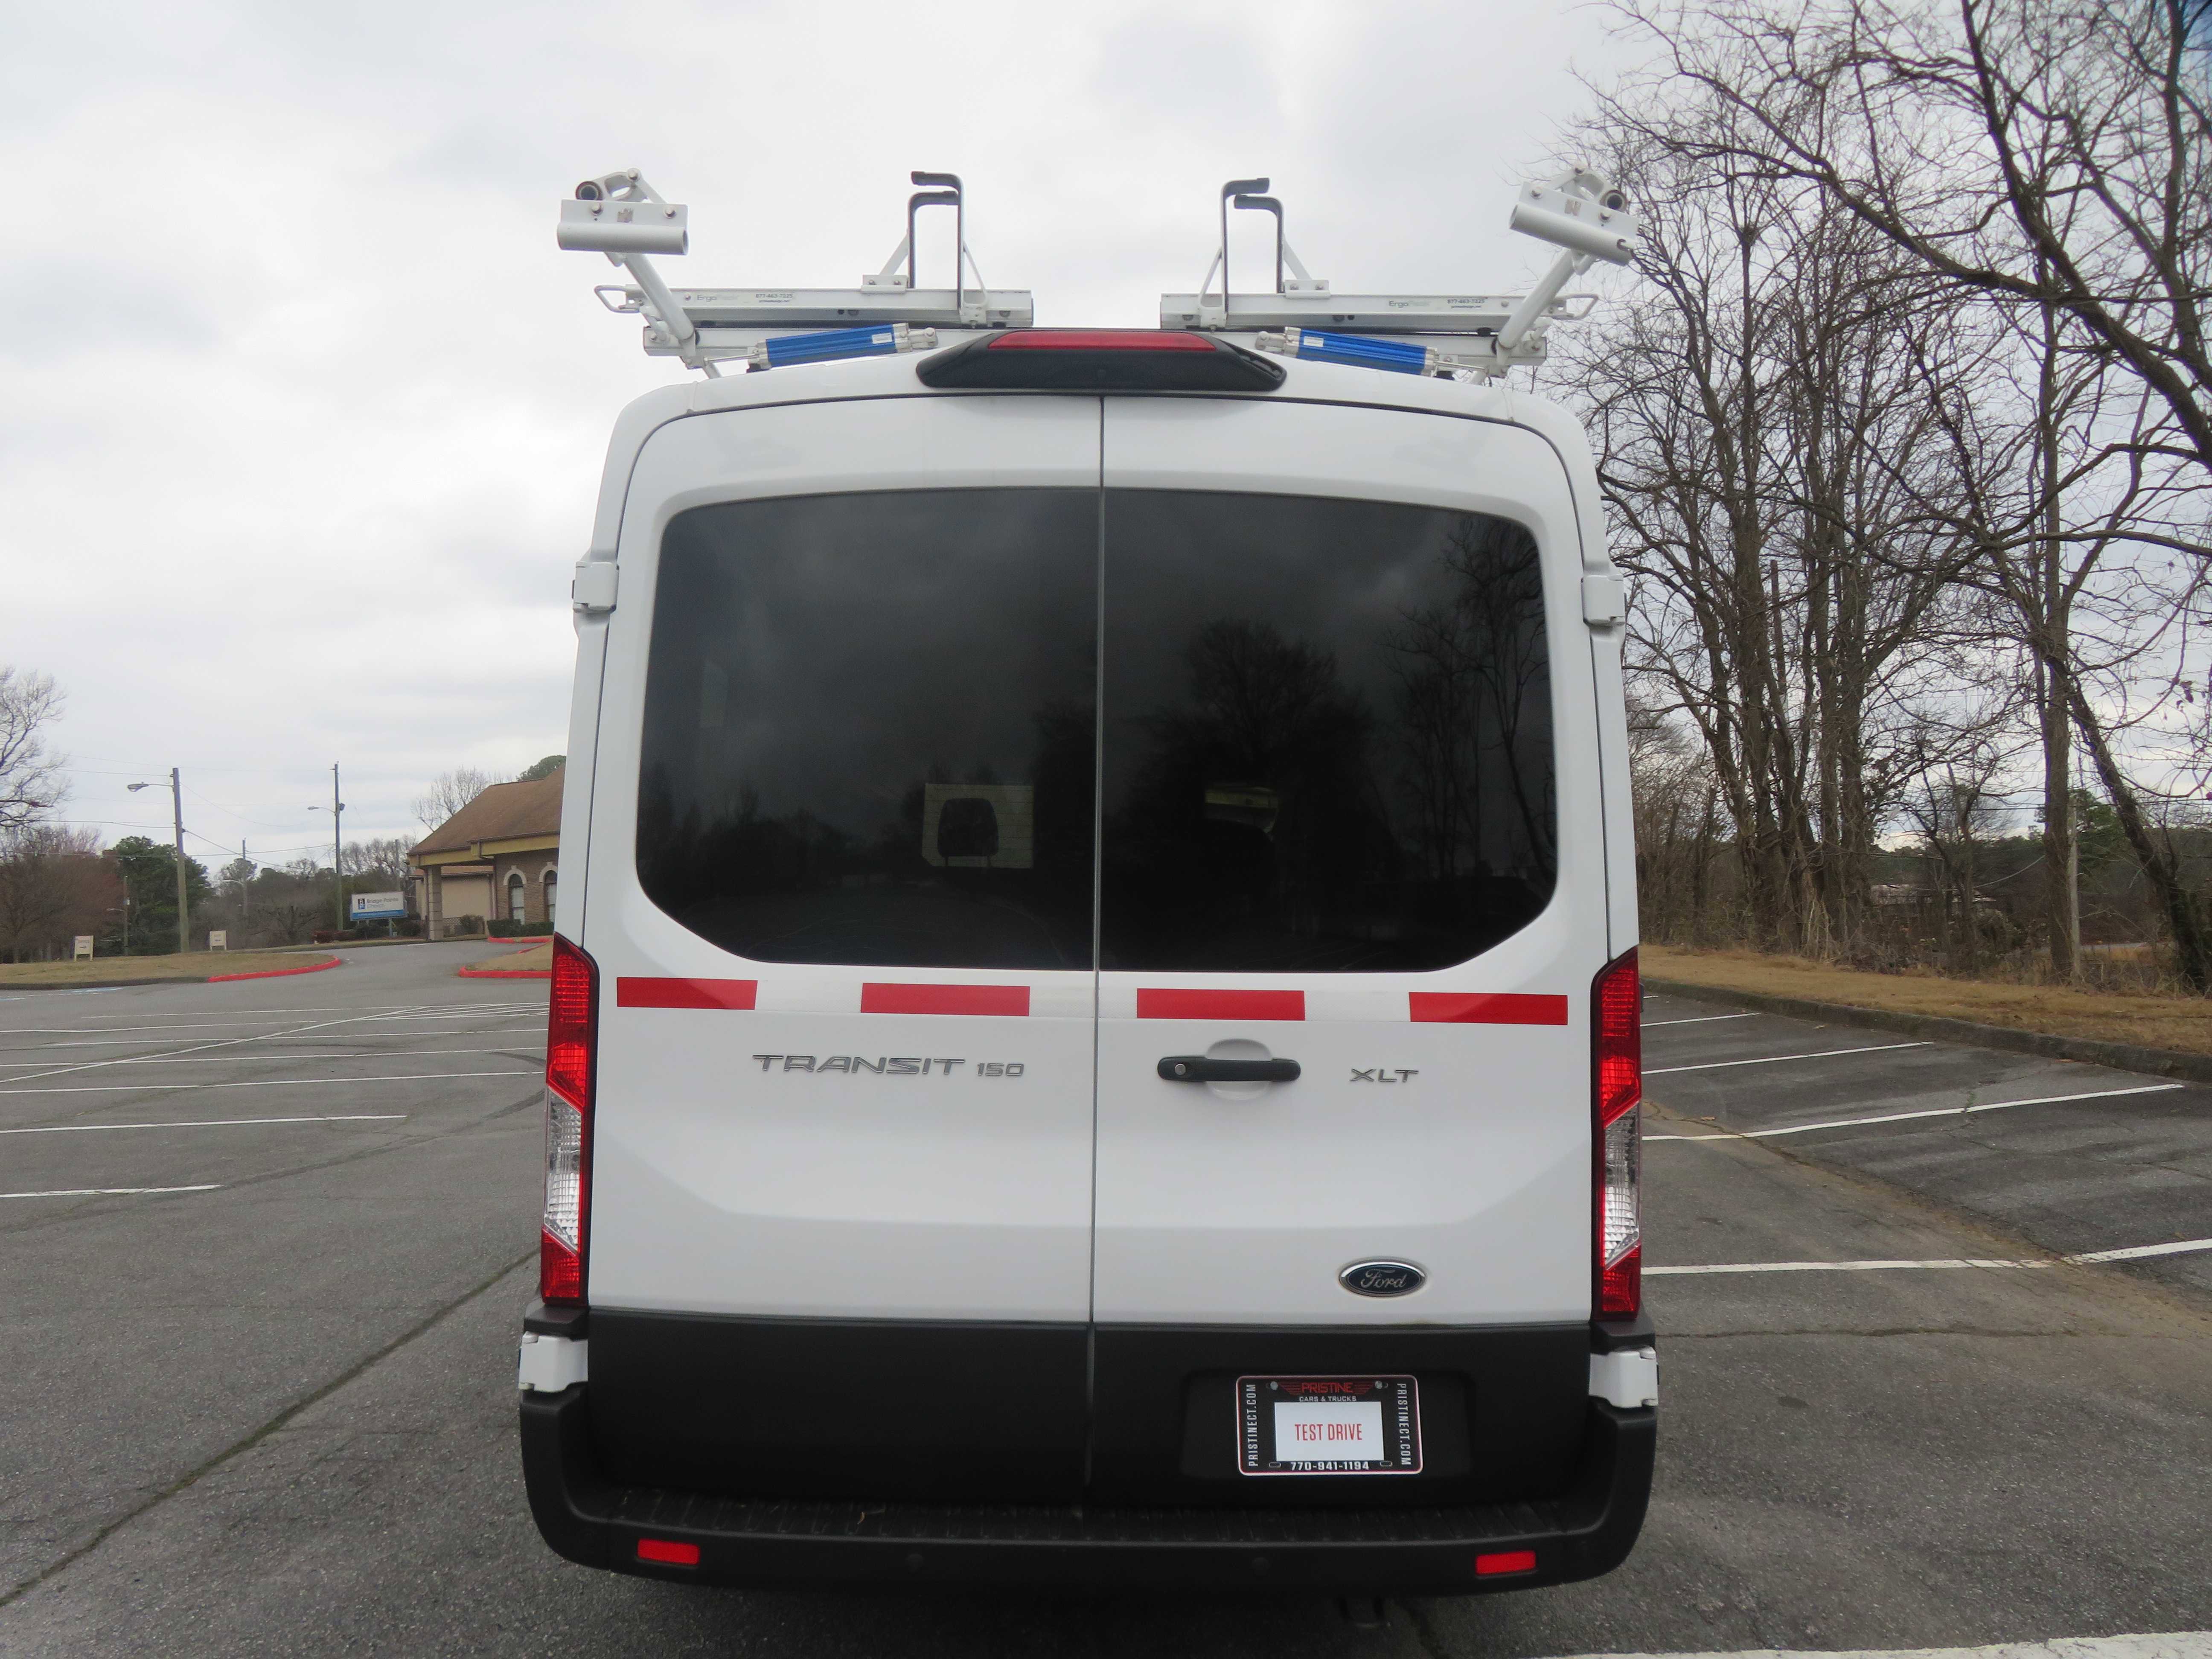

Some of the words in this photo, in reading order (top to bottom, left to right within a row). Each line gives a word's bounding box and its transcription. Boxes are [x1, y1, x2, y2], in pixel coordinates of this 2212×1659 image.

[753, 1054, 966, 1075] TRANSIT
[977, 1062, 1025, 1077] 150
[1349, 1068, 1419, 1083] XLT
[1360, 1269, 1407, 1288] Ford
[1301, 1382, 1354, 1393] PRISTINE
[1246, 1384, 1258, 1467] PRISTINECT.COM
[1295, 1424, 1323, 1441] TEST
[1328, 1423, 1362, 1441] DRIVE
[1397, 1383, 1411, 1465] PRISTINECT.COM
[1290, 1461, 1369, 1470] 770-941-1194
